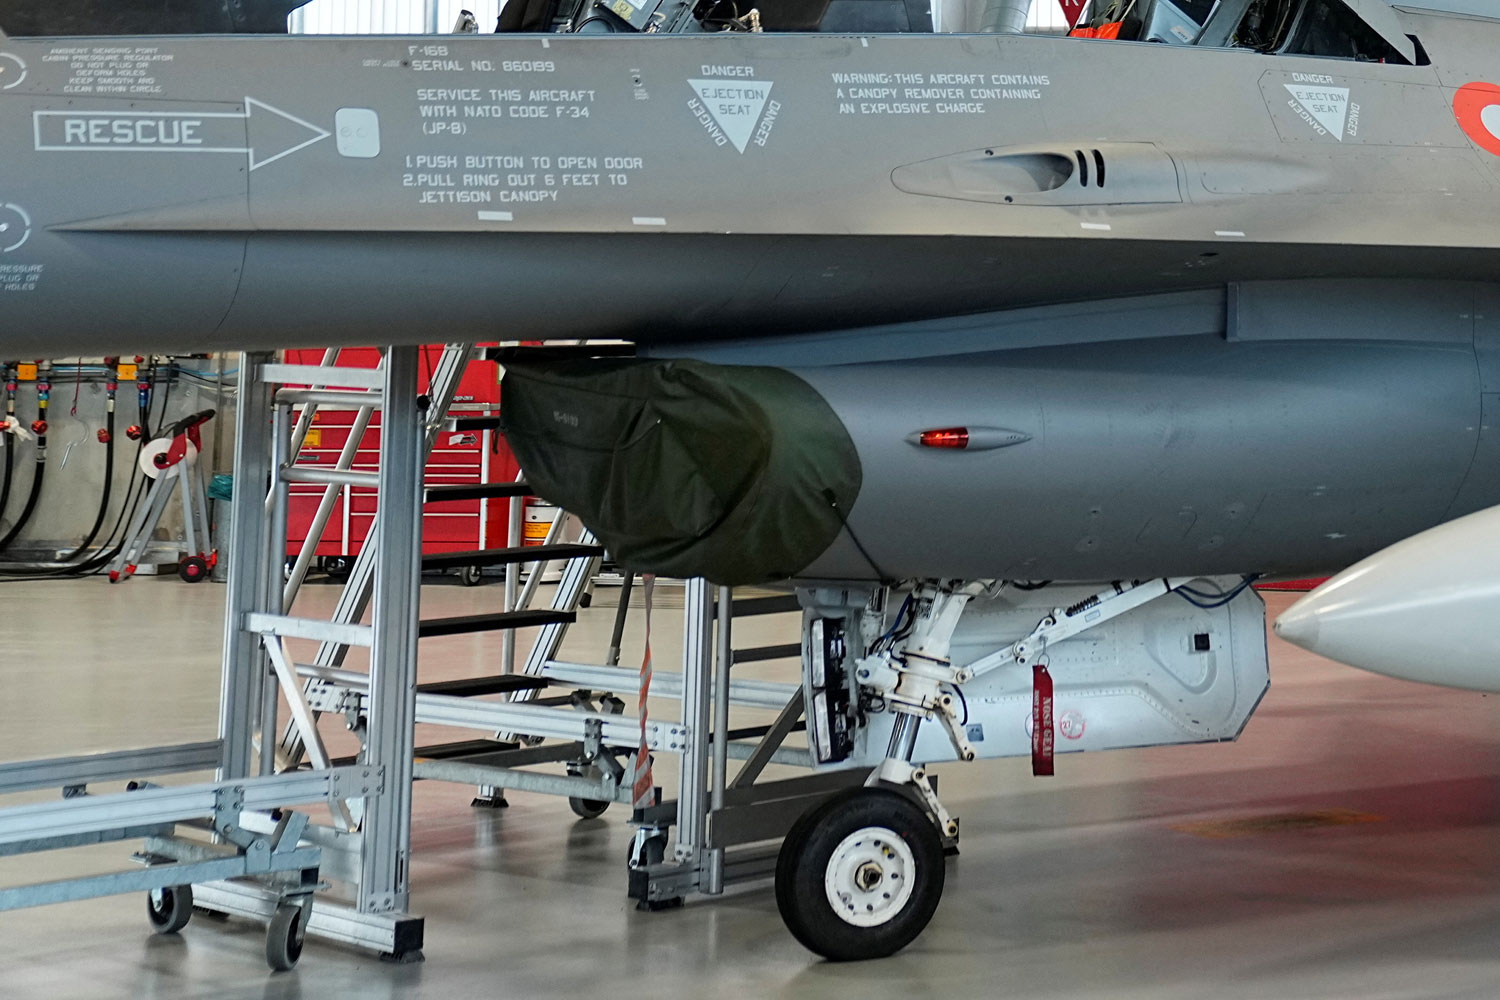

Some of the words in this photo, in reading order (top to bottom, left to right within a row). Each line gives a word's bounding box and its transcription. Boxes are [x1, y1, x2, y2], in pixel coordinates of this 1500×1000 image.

[411, 60, 464, 71] SERIAL
[471, 61, 496, 72] NO.
[502, 61, 555, 72] 860199
[701, 65, 754, 77] DANGER
[929, 74, 985, 85] AIRCRAFT
[991, 75, 1050, 86] CONTAINS
[1292, 72, 1334, 84] DANGER
[129, 85, 162, 93] CIRCLE
[701, 88, 764, 100] EJECTION
[836, 88, 844, 99] A
[849, 88, 898, 99] CANOPY
[904, 88, 964, 99] REMOVER
[970, 89, 1041, 100] CONTAINING
[416, 89, 481, 101] SERVICE
[489, 90, 522, 101] THIS
[528, 90, 596, 102] AIRCRAFT
[1296, 91, 1346, 102] EJECTION
[419, 105, 457, 118] WITH
[464, 106, 502, 118] NATO
[509, 106, 550, 118] CODE
[556, 106, 590, 118] F-34
[719, 104, 751, 115] SEAT
[839, 103, 855, 114] AN
[860, 103, 931, 114] EXPLOSIVE
[935, 103, 985, 114] CHARGE
[1312, 104, 1338, 113] SEAT
[687, 98, 728, 146] DANGER
[753, 99, 782, 147] DANGER
[1287, 99, 1327, 136] DANGER
[1347, 102, 1360, 137] DANGER
[64, 118, 203, 144] RESCUE
[422, 121, 468, 135] (JP-8)
[465, 156, 524, 169] BUTTON
[531, 156, 551, 169] TO
[557, 157, 598, 169] OPEN
[604, 157, 644, 169] DOOR
[463, 174, 500, 186] RING
[507, 174, 537, 186] OUT
[544, 174, 555, 186] 6
[562, 174, 600, 186] FEET
[608, 174, 628, 186] TO
[418, 190, 492, 203] JETTISON
[500, 190, 559, 203] CANOPY
[1043, 696, 1052, 728] NOSE
